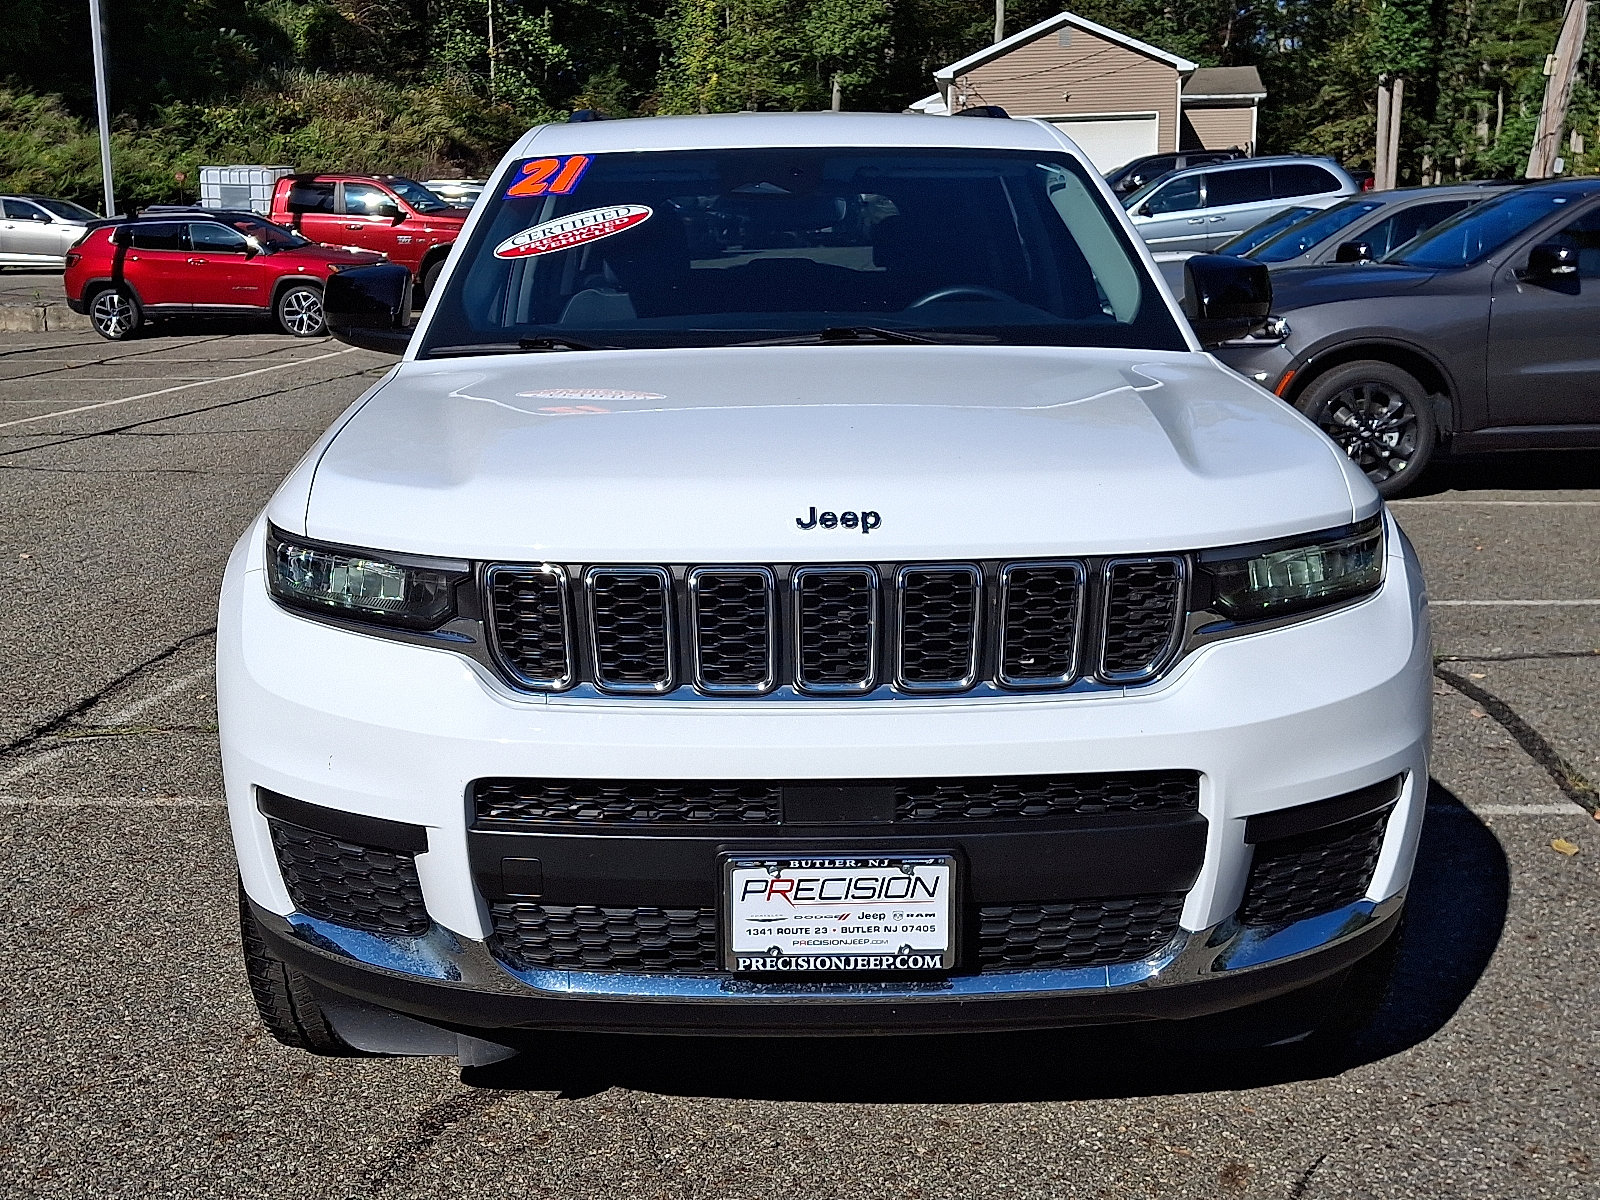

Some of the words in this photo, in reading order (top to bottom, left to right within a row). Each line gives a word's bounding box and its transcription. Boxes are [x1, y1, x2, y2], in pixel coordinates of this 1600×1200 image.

[507, 156, 590, 197] 21
[511, 206, 631, 246] CERTIFIED
[519, 216, 630, 252] PRE-OWNED
[538, 224, 617, 251] VEHICLE
[795, 506, 882, 534] Jeep
[789, 859, 862, 868] BUTLER,
[868, 859, 890, 867] NJ
[740, 876, 940, 905] PRECISION
[857, 911, 887, 921] Jeep
[745, 928, 773, 936] 1341
[777, 927, 811, 935] ROUTE
[814, 927, 828, 935] 23
[840, 925, 881, 934] BUTLER
[883, 925, 898, 933] NJ
[901, 925, 936, 933] 07405
[792, 938, 889, 946] PRECISIONJEEP.COM
[737, 955, 943, 971] PRECISIONJEEP.COM
